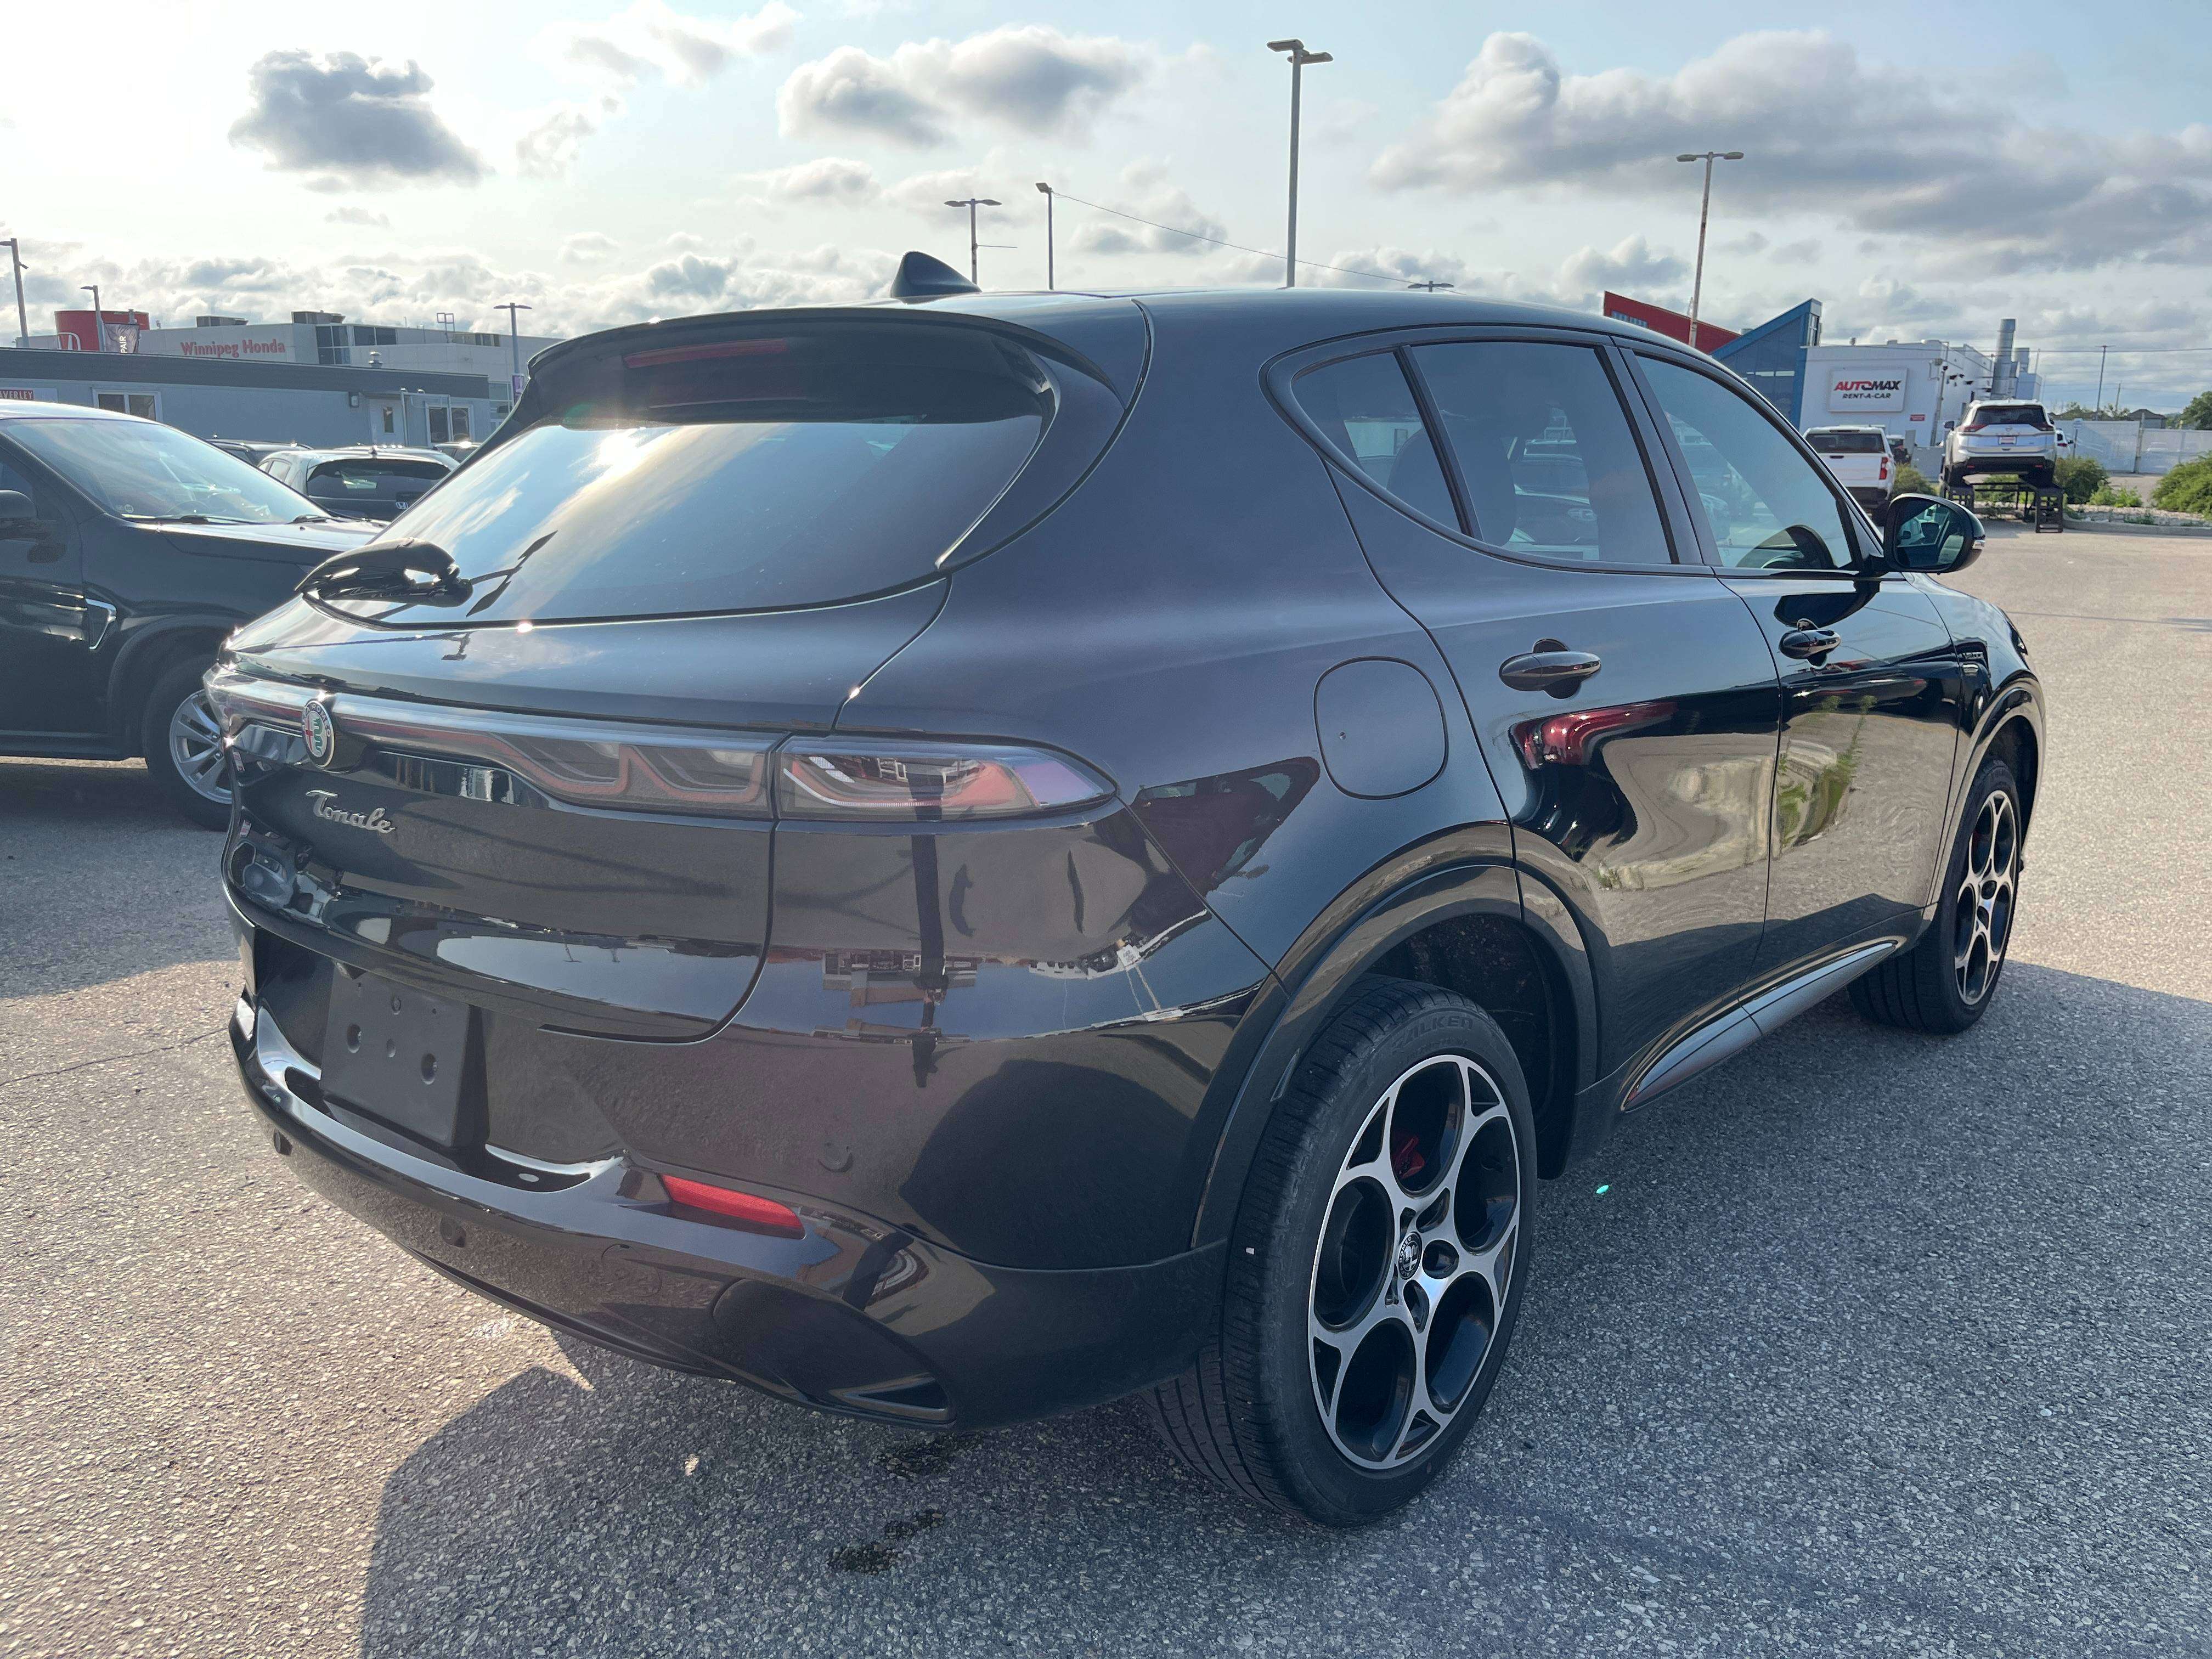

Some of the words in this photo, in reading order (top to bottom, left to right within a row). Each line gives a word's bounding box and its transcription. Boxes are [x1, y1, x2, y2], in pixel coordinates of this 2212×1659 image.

[180, 341, 239, 358] Winnipeg
[242, 338, 285, 353] Honda
[1834, 380, 1901, 391] AUTOMAX
[306, 789, 396, 833] Tonale
